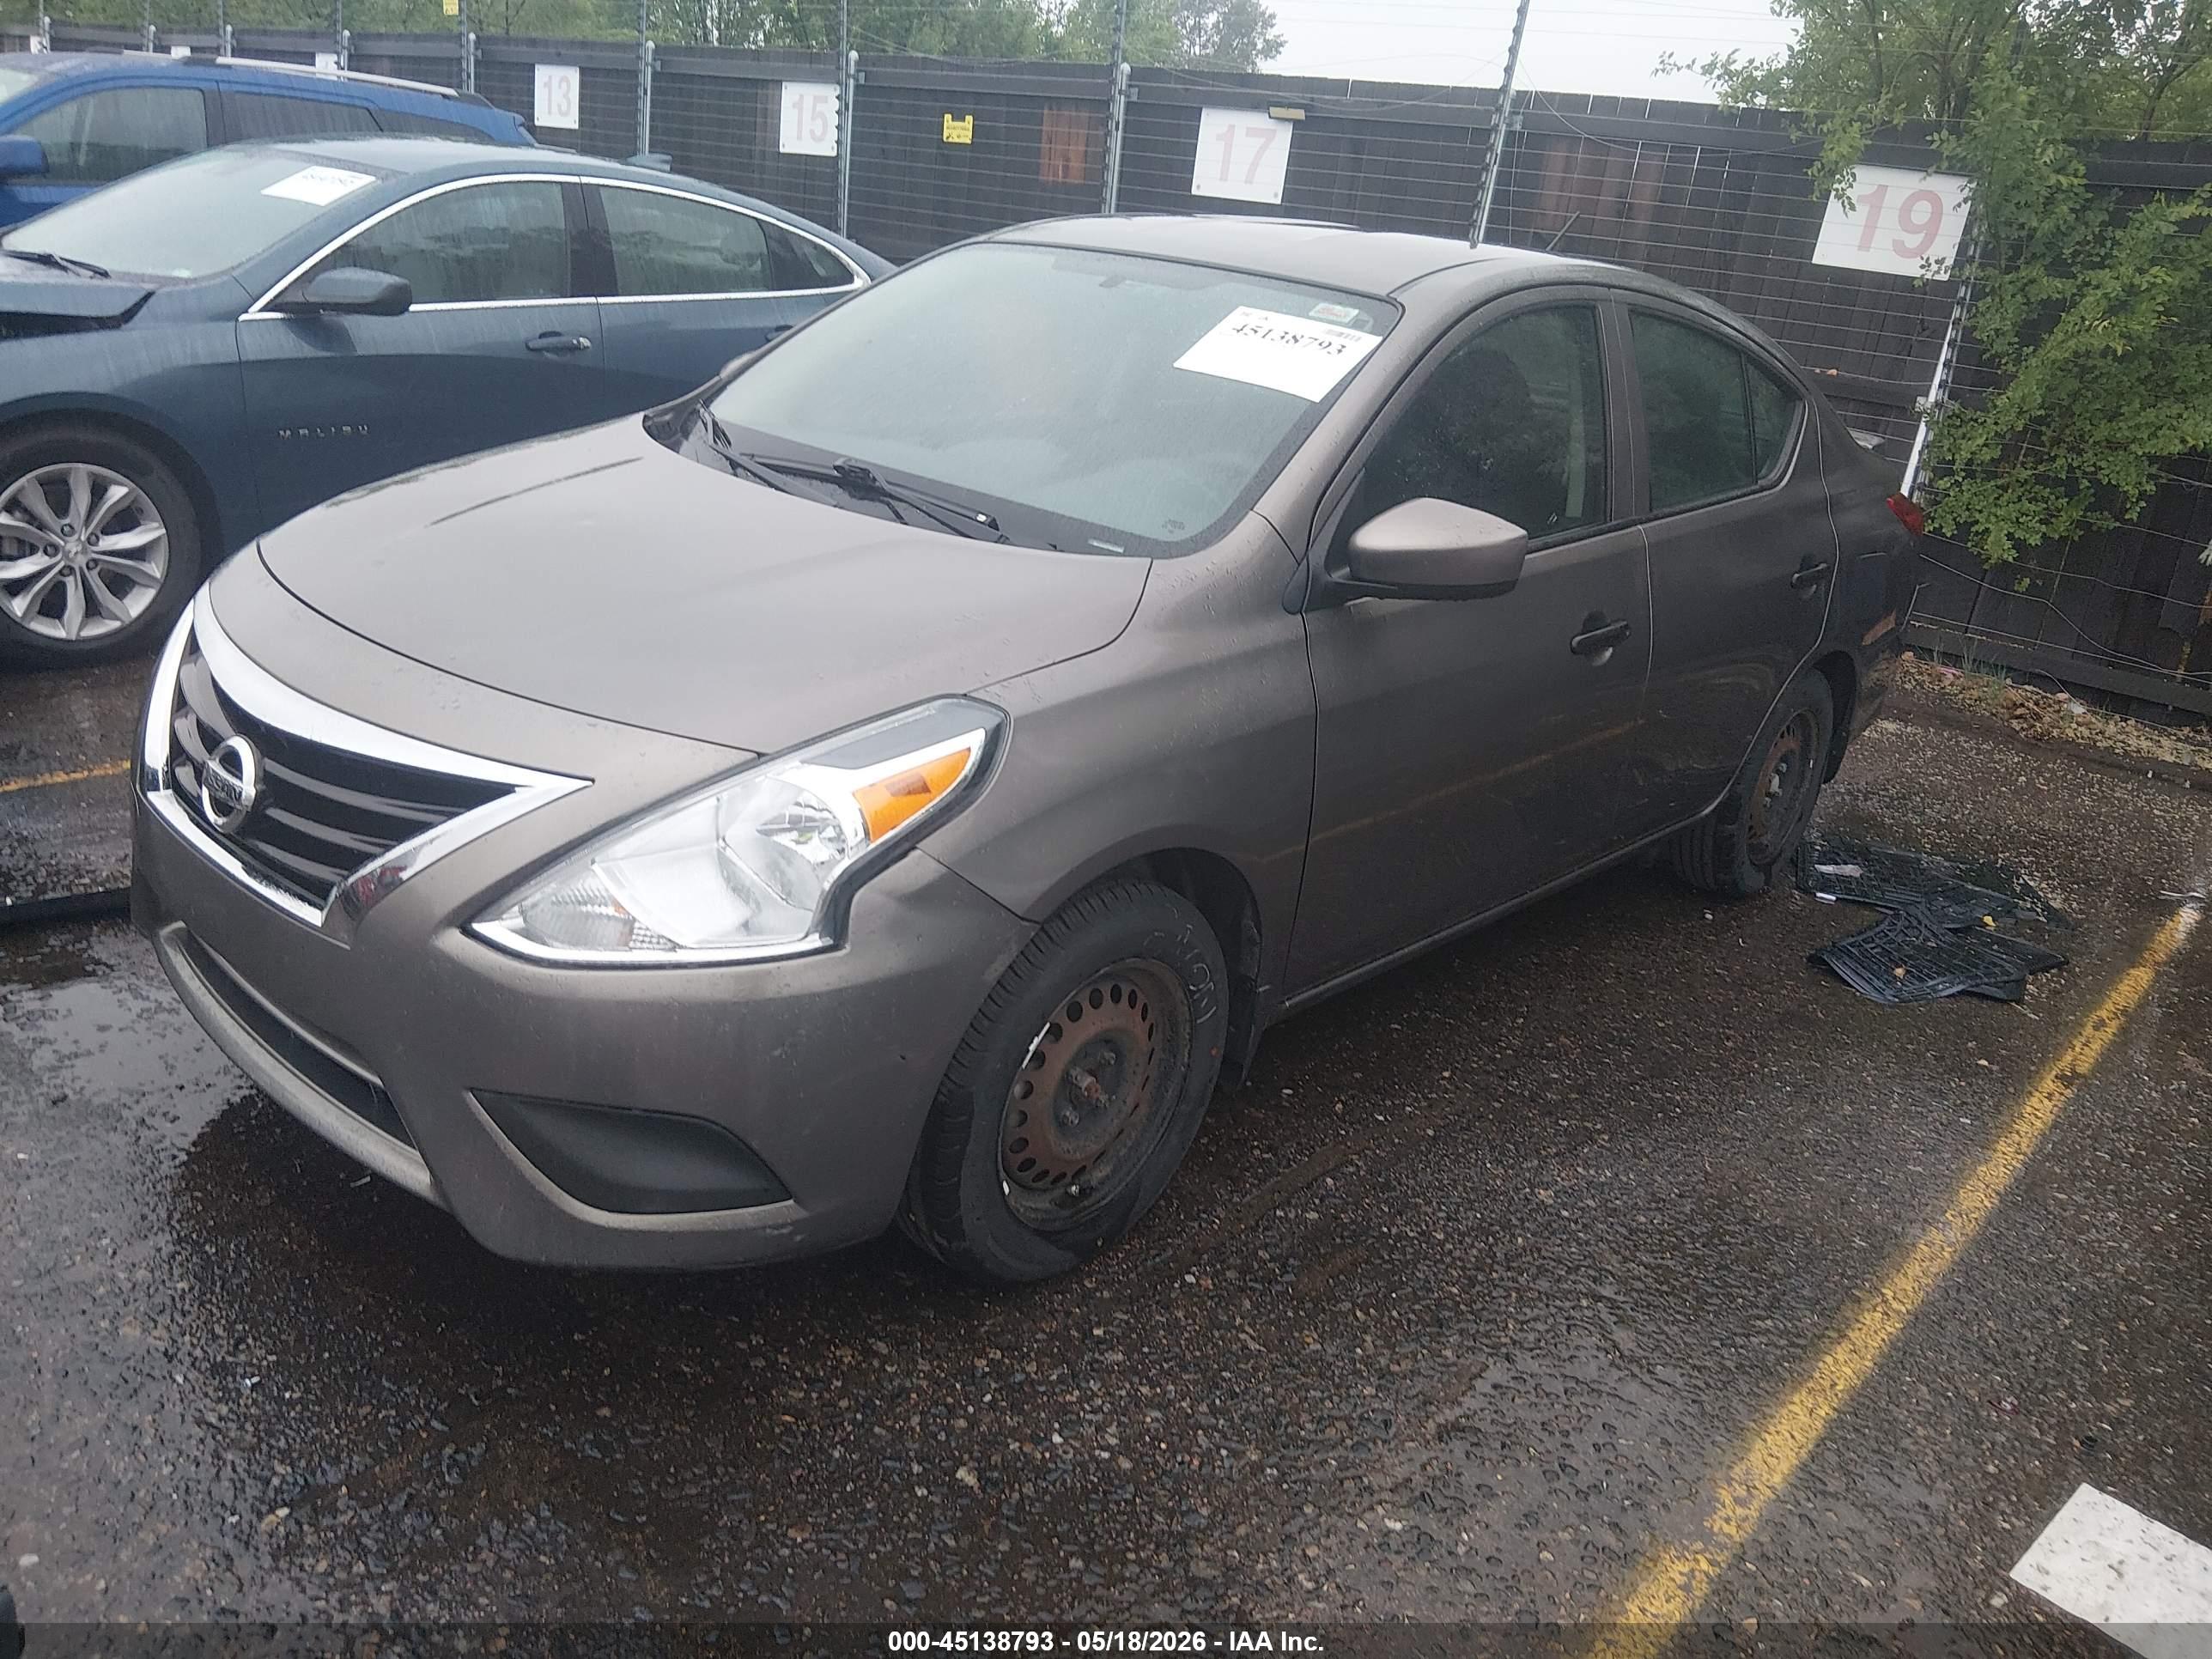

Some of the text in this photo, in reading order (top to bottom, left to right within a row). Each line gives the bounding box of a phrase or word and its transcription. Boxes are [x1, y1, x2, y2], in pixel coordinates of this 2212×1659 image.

[544, 75, 571, 117] 13
[792, 94, 829, 143] 15
[1215, 124, 1277, 185] 17
[1856, 184, 1944, 259] 19
[1232, 323, 1347, 356] 45138793
[278, 424, 369, 440] MALIBU
